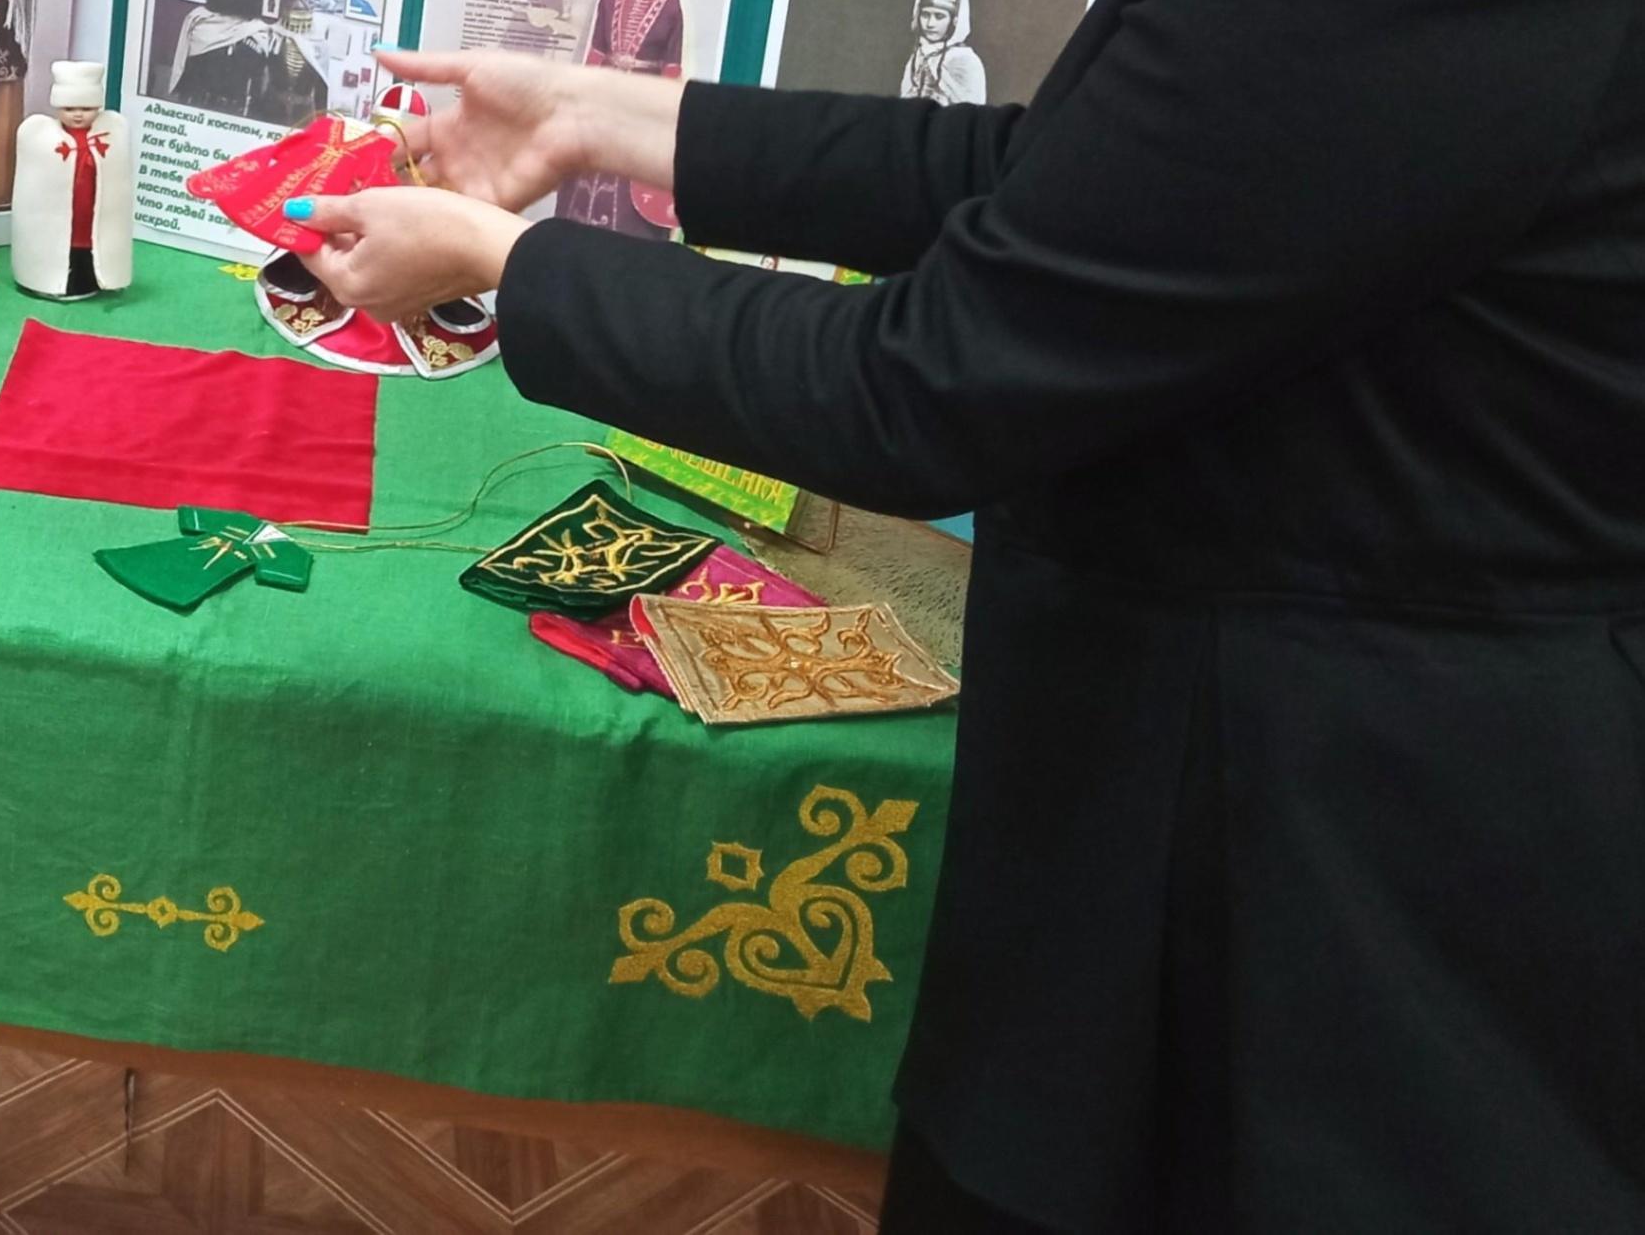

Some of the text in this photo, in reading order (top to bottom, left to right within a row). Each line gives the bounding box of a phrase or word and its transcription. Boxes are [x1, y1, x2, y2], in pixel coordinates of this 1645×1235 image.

[143, 120, 187, 137] такой.
[144, 104, 204, 124] Адыгский
[207, 118, 263, 139] костюм,
[142, 134, 230, 161] Как будто бы
[140, 152, 201, 171] неземной.
[139, 165, 183, 182] В тебе
[137, 196, 162, 209] Что
[166, 204, 204, 220] людей
[135, 212, 180, 230] искрой.
